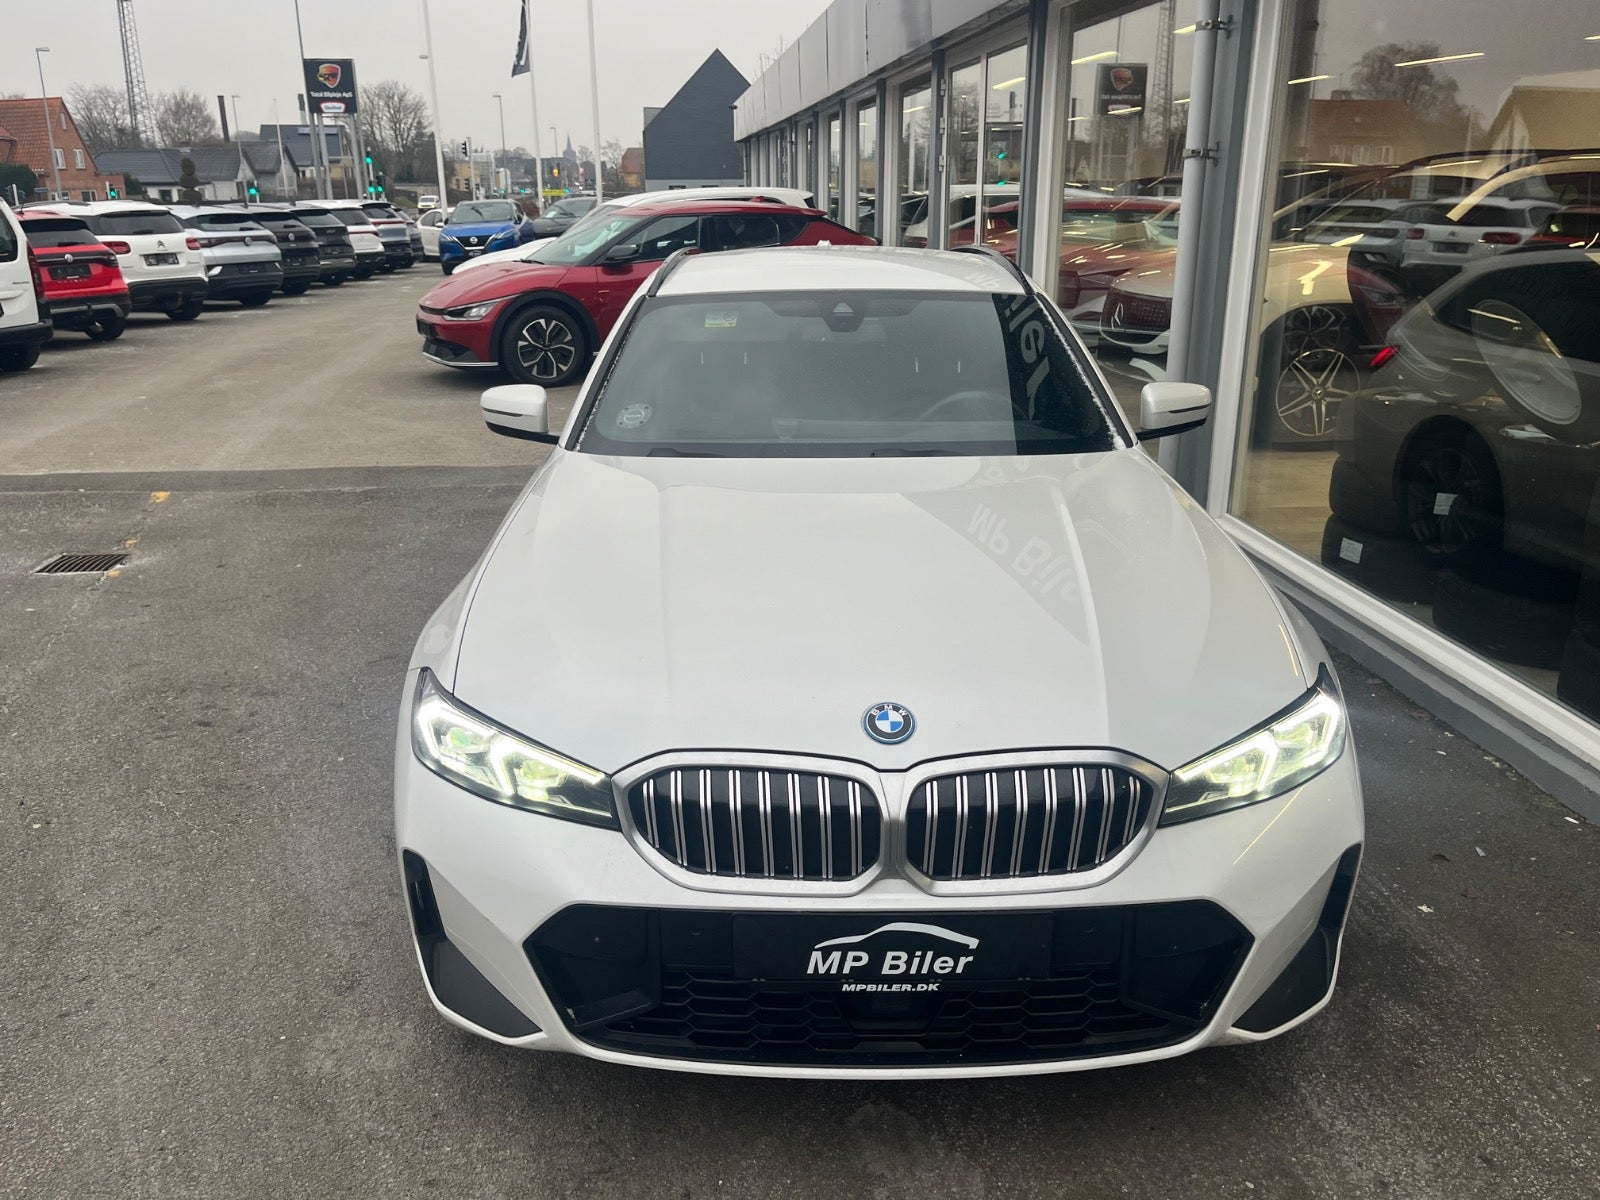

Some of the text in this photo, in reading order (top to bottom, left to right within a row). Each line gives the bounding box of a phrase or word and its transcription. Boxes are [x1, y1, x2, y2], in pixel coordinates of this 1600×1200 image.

[871, 704, 908, 716] BMW
[806, 950, 974, 975] MP Biler
[842, 983, 940, 992] MPBILER.DK
